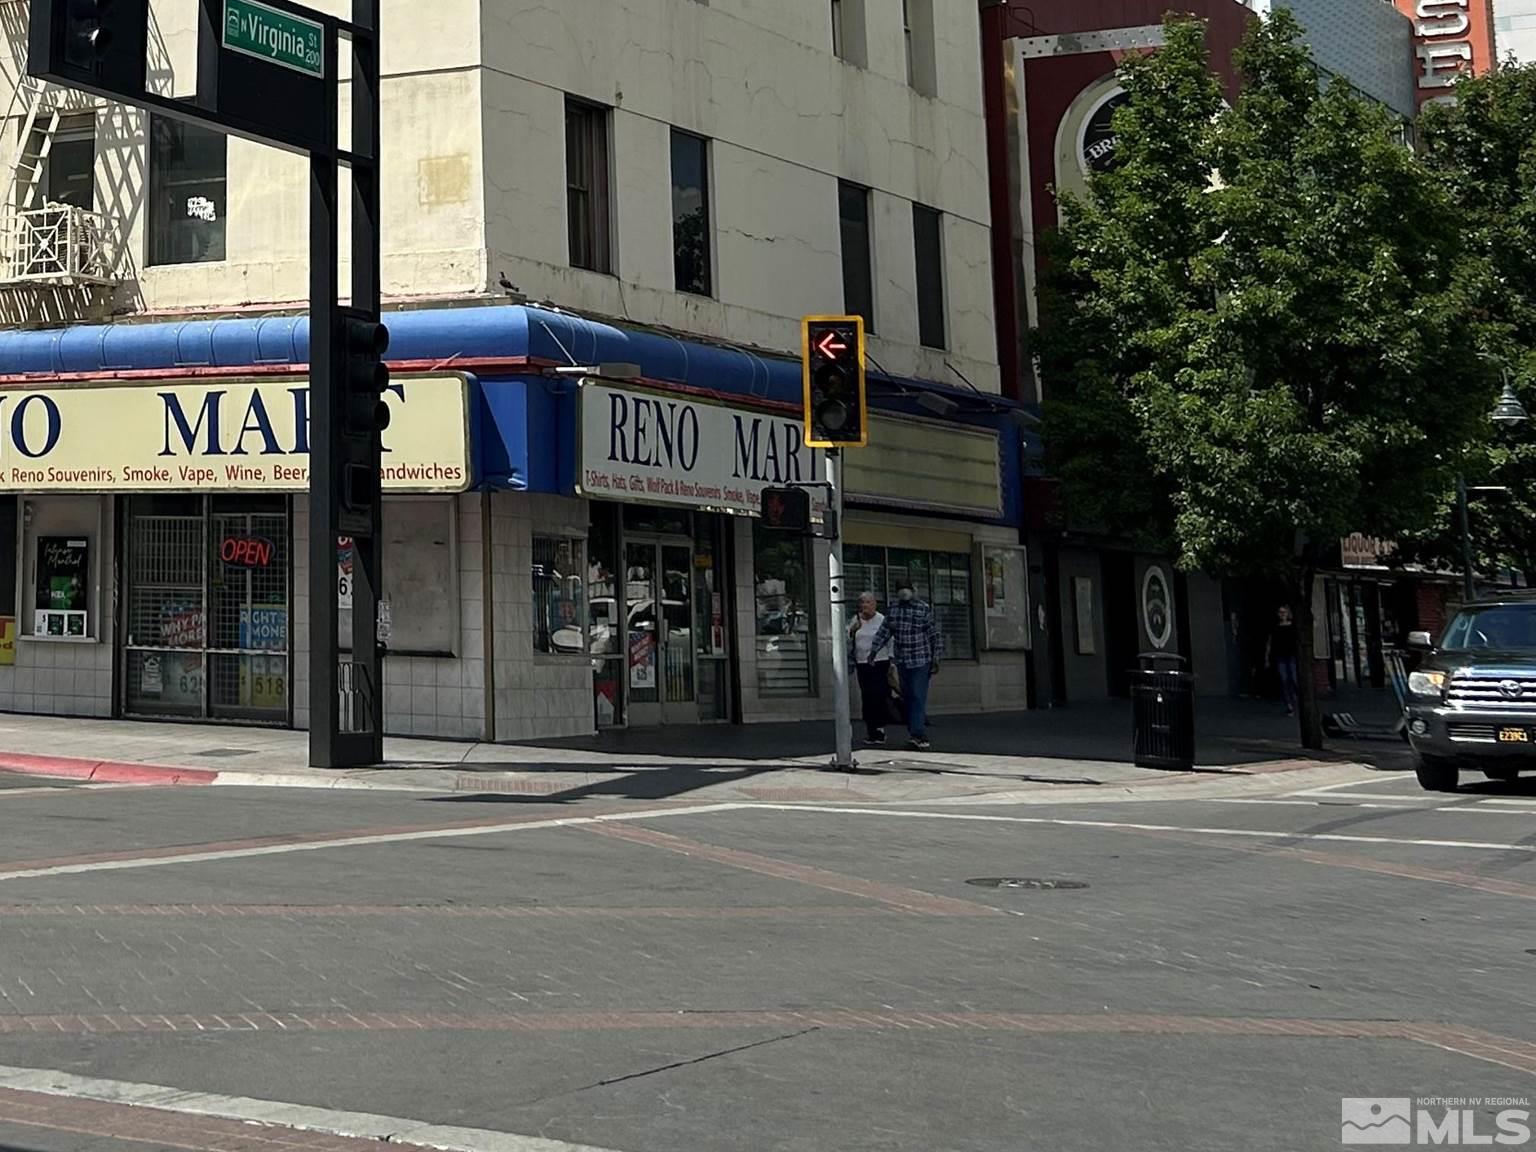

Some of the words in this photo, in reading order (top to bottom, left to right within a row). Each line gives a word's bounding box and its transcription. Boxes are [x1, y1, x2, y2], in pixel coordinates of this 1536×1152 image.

[248, 13, 305, 58] Virginia
[305, 49, 320, 66] 200
[608, 393, 699, 471] RENO
[12, 467, 44, 482] Reno
[48, 466, 116, 483] Souvenirs,
[123, 466, 172, 483] Smoke,
[178, 465, 218, 485] Vape,
[225, 464, 266, 482] Wine,
[380, 463, 461, 479] andwiches
[221, 538, 270, 566] OPEN
